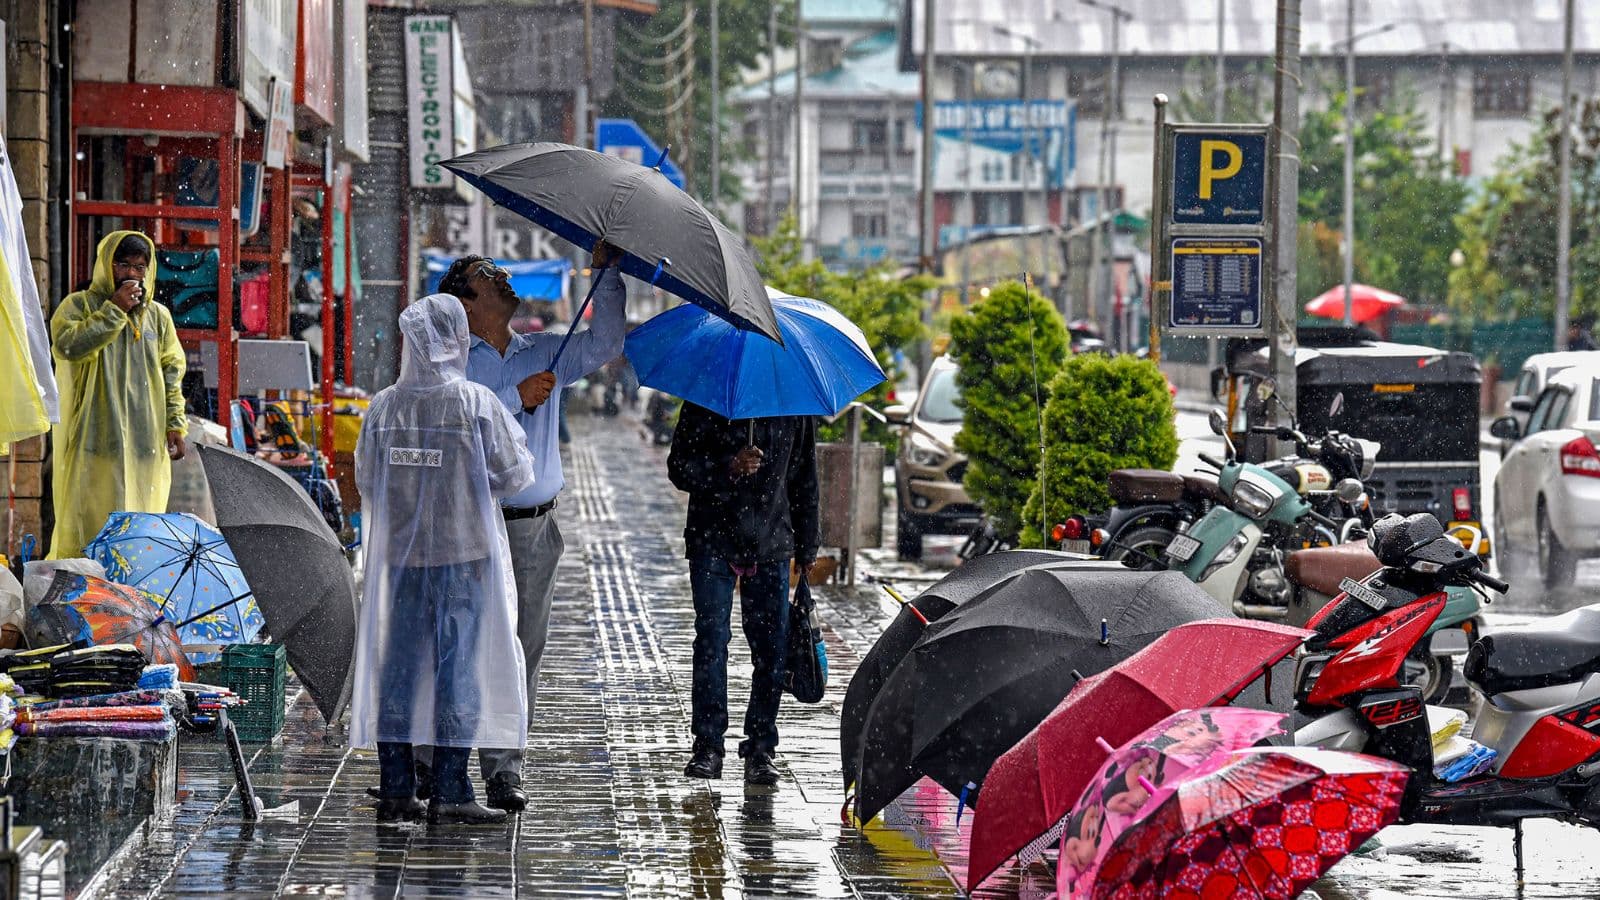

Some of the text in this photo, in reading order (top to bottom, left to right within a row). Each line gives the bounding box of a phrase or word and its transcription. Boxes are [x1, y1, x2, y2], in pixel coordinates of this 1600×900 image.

[409, 21, 449, 33] WANI
[420, 34, 441, 183] ELECTRONICS
[1199, 140, 1243, 199] P
